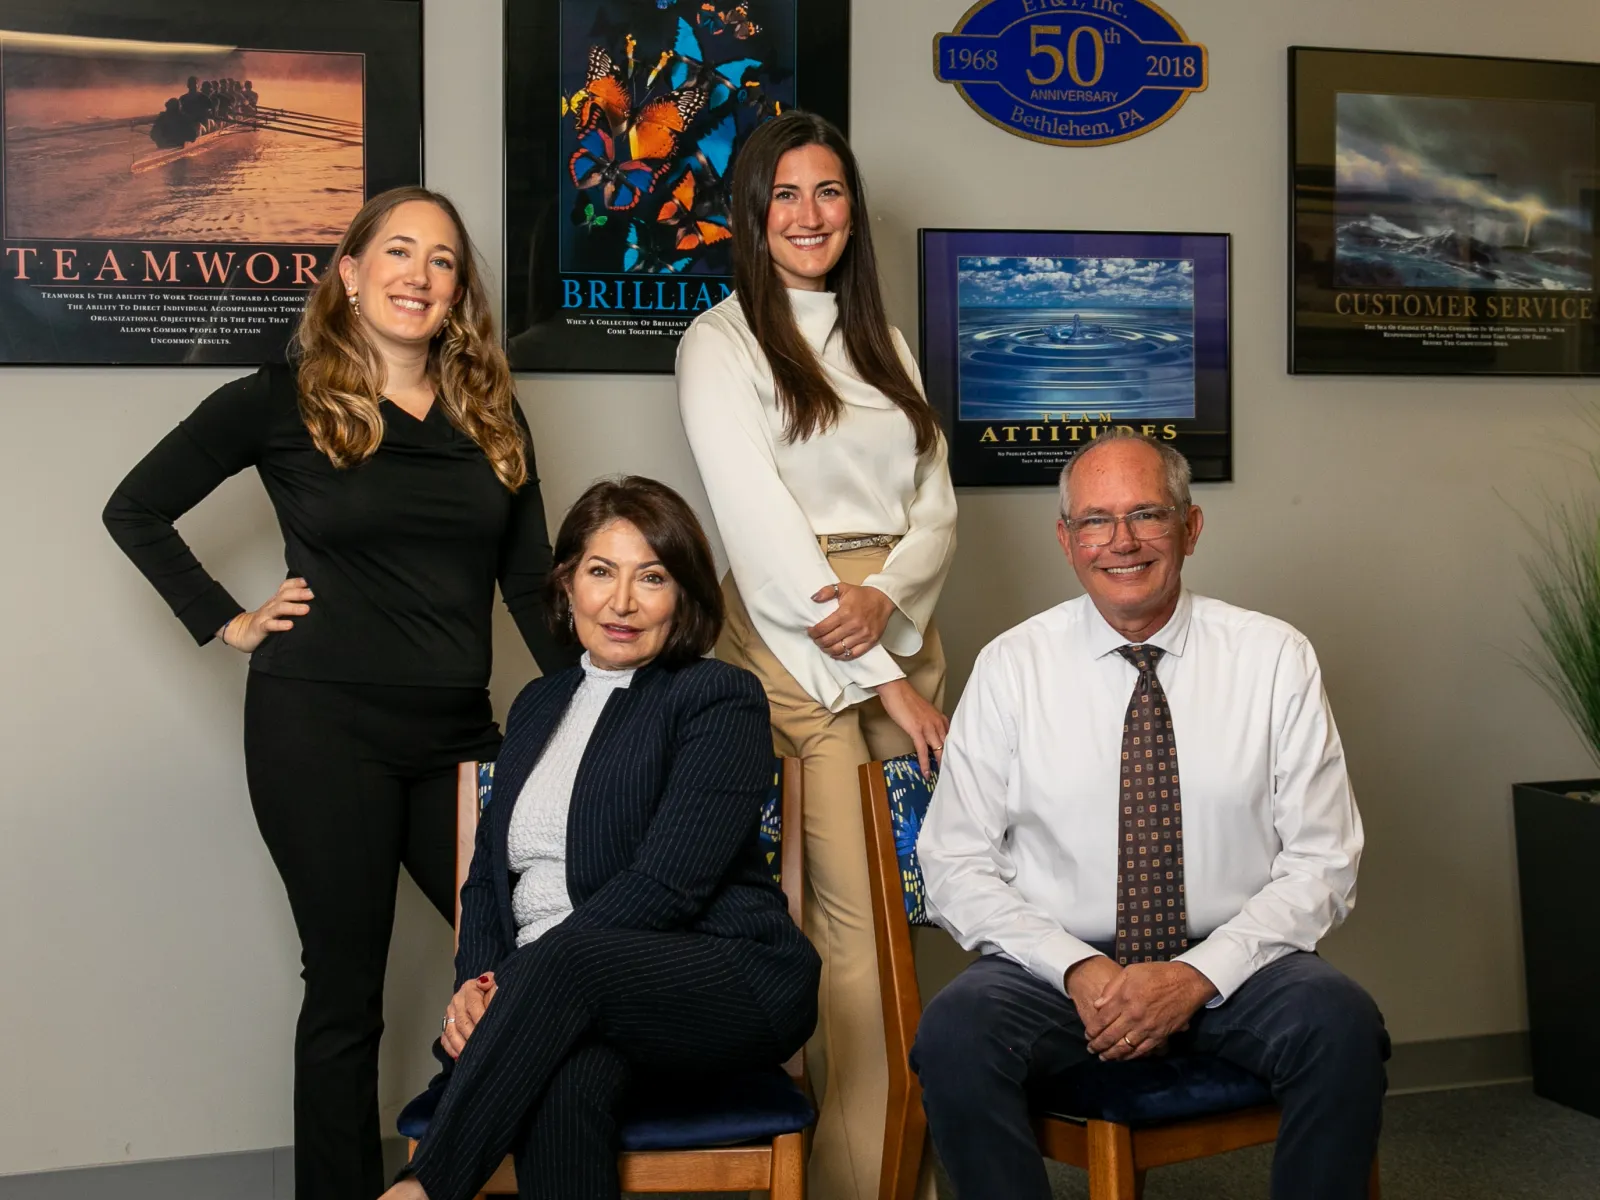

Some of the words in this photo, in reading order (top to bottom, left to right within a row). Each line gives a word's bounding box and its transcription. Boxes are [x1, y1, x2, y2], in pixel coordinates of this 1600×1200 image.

[948, 48, 998, 70] 1968
[1146, 56, 1196, 78] 2018
[1030, 89, 1118, 102] ANNIVERSARY
[1010, 105, 1114, 136] Bethlehem,
[1118, 108, 1146, 130] PA
[1336, 293, 1478, 316] CUSTOMER
[1486, 296, 1593, 319] SERVICE
[1041, 412, 1113, 423] TEAM
